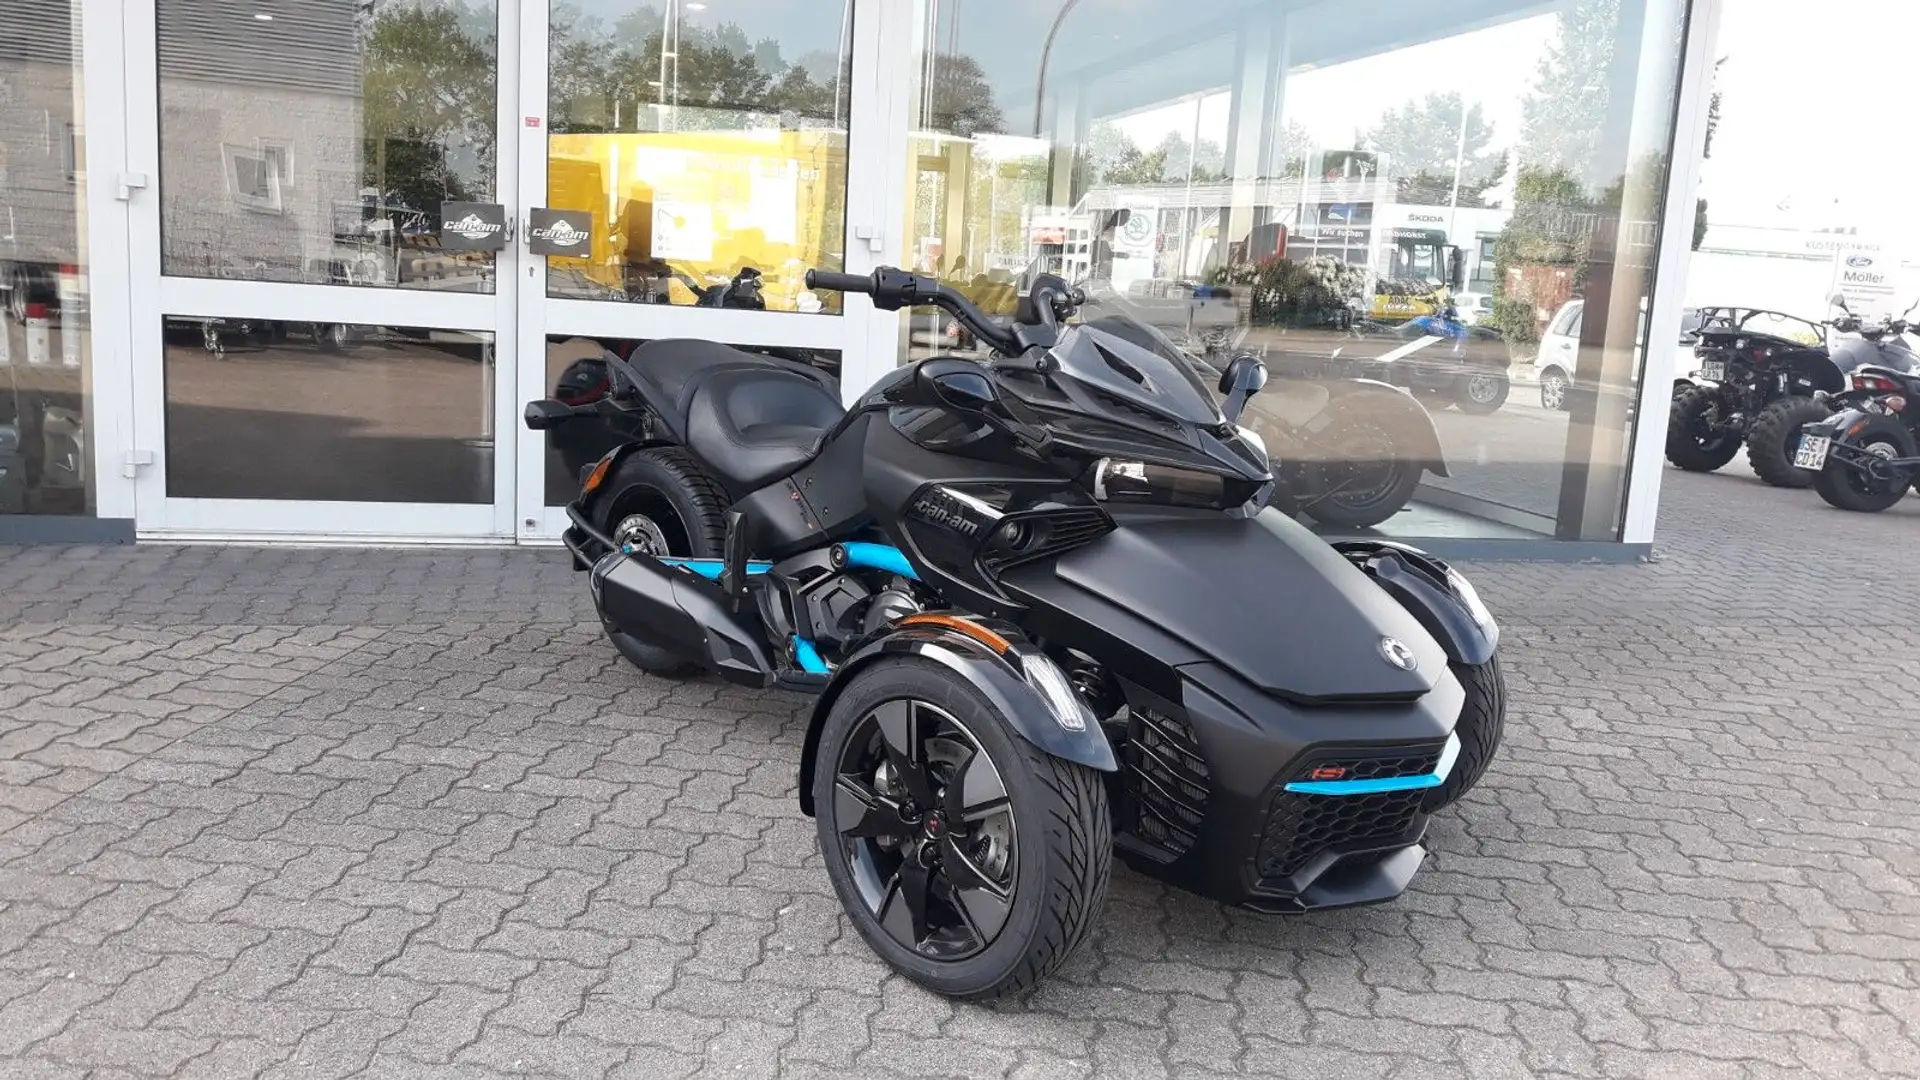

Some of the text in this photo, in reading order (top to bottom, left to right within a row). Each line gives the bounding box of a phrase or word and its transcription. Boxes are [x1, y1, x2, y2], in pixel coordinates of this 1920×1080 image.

[1408, 213, 1444, 222] ŠKODA
[1843, 271, 1885, 284] Möller
[913, 500, 979, 536] can-am
